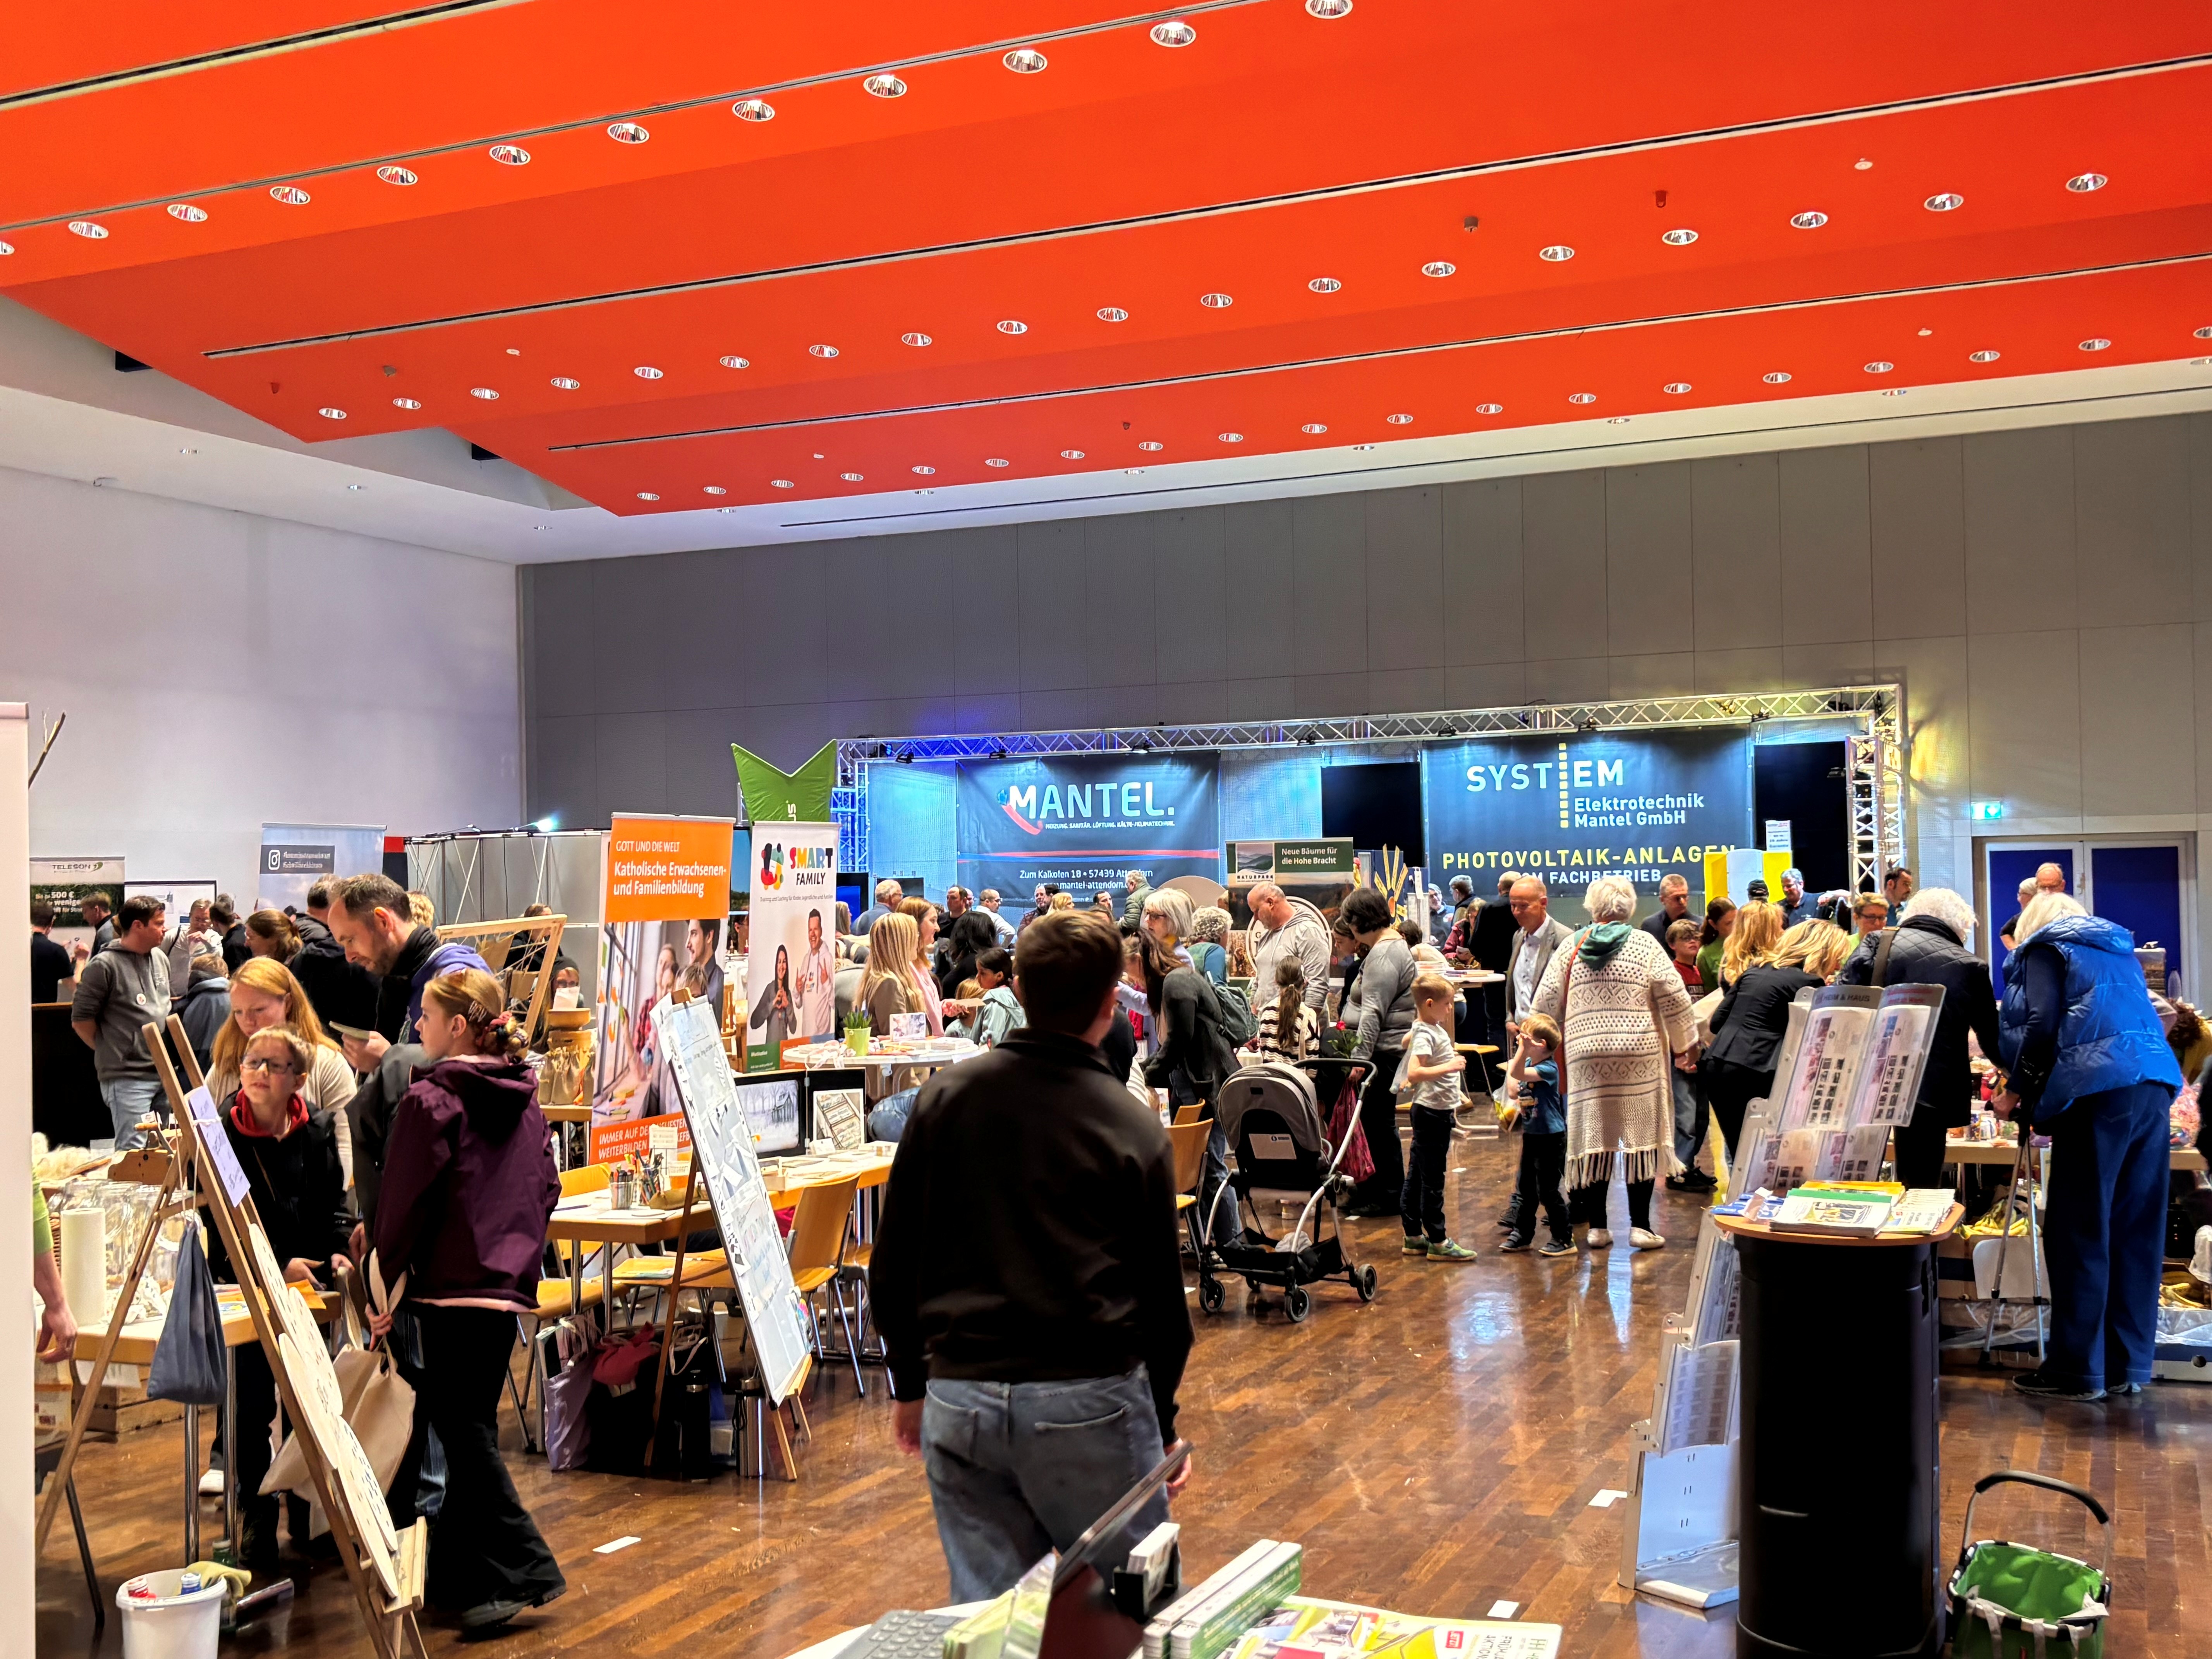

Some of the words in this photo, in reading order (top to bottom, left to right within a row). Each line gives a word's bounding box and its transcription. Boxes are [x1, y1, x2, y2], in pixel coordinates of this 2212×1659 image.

[1575, 793, 1704, 812] Elektrotechnik
[1575, 812, 1632, 828] Mantel
[1637, 810, 1686, 825] GmbH
[616, 841, 634, 852] GOTT
[635, 841, 651, 852] UND
[652, 842, 663, 852] DIE
[664, 842, 680, 852] WELT
[789, 847, 833, 869] SMART
[614, 860, 666, 876] Katholische
[669, 861, 726, 876] Erwachsenen-
[1020, 870, 1036, 879] Zum
[1038, 870, 1069, 878] Kalkofen
[1089, 869, 1114, 878] 57439
[1116, 869, 1153, 878] Attorn
[796, 872, 826, 885] FAMILY
[613, 879, 632, 895] und
[634, 879, 704, 898] Familienbildung
[54, 898, 81, 907] wenige
[599, 1129, 623, 1145] IMMER
[624, 1126, 639, 1139] AUF
[639, 1125, 649, 1137] DE
[599, 1139, 647, 1159] WEITERBILDEN
